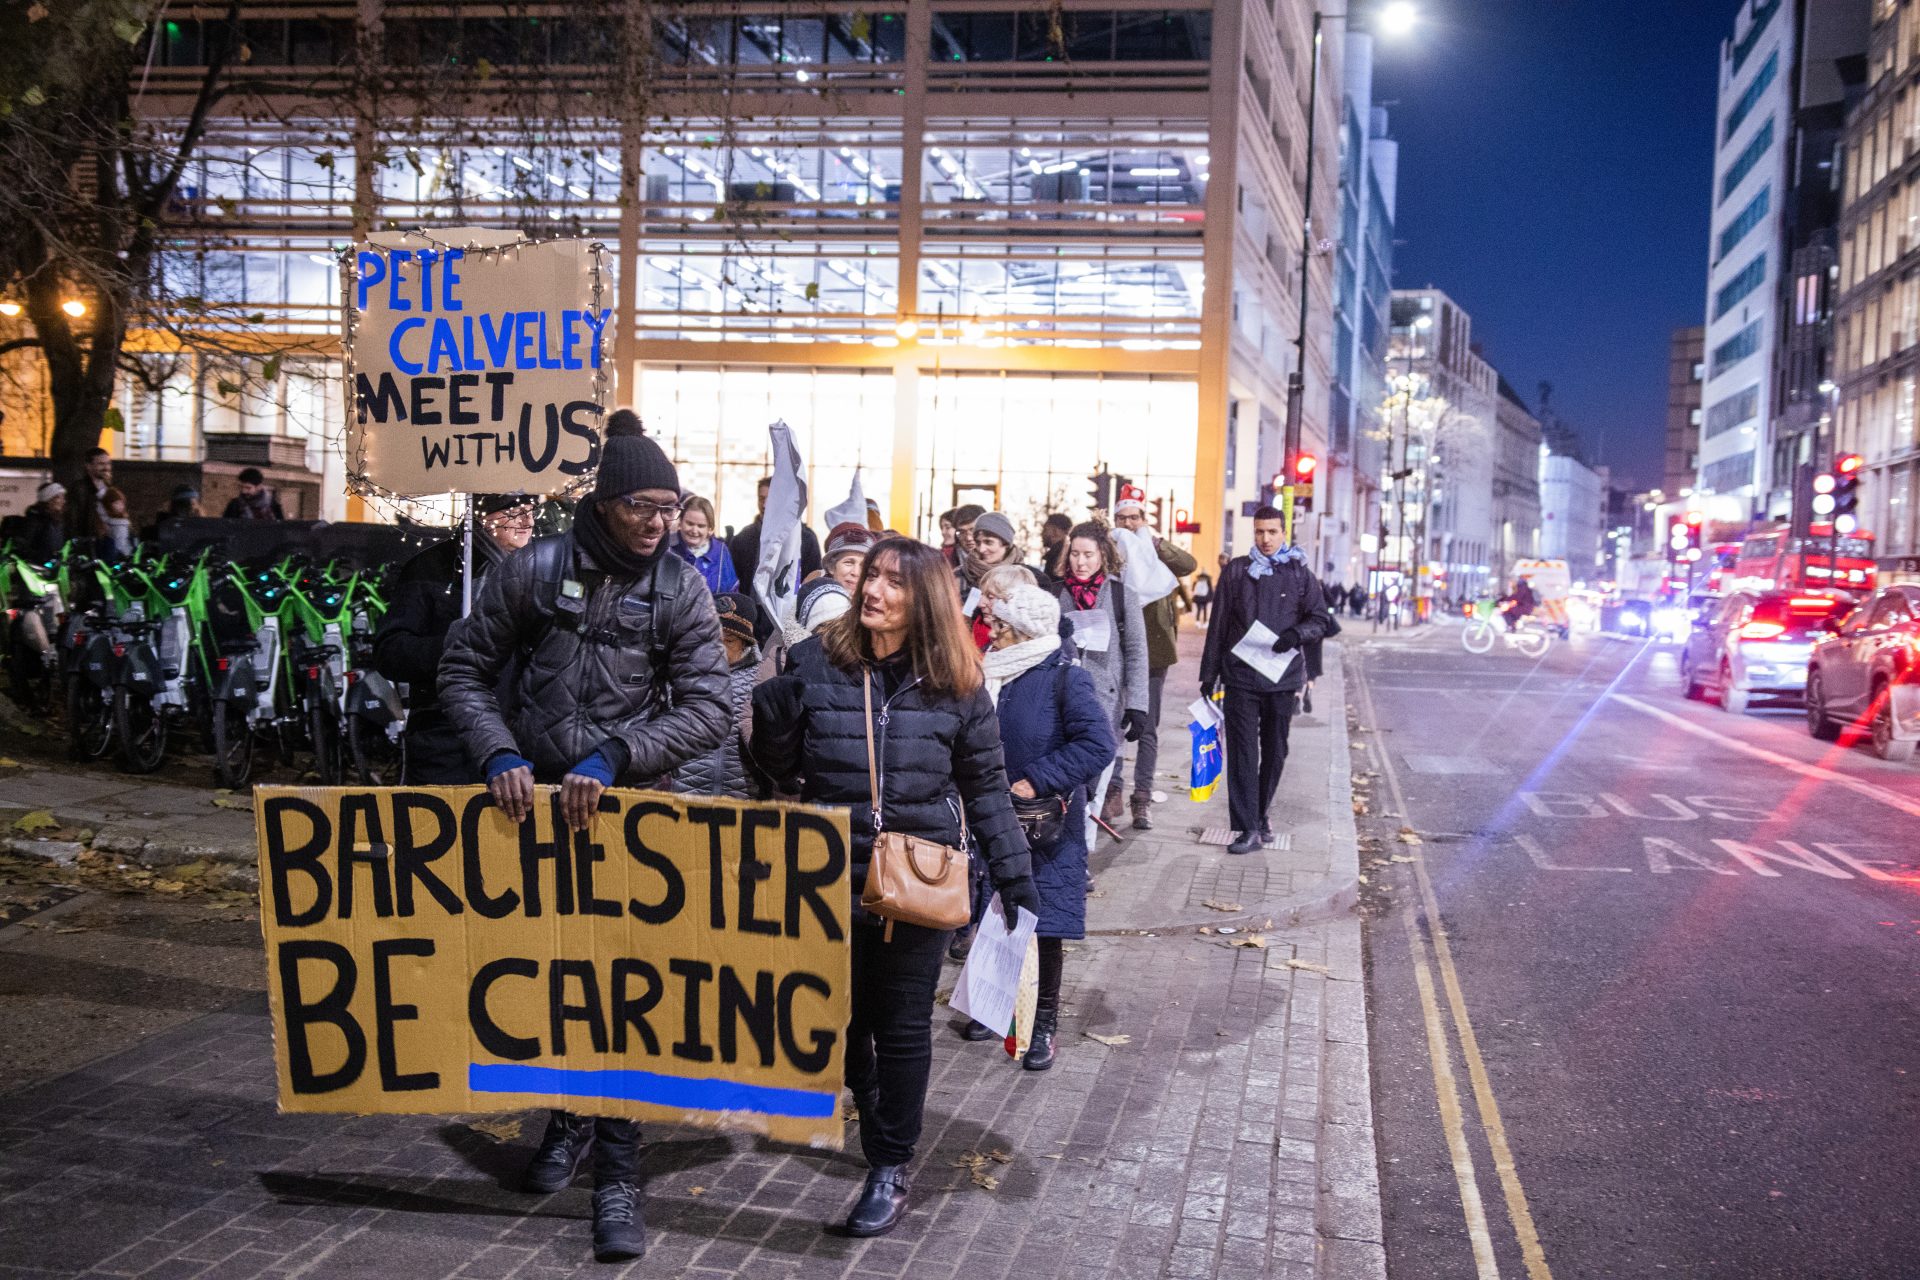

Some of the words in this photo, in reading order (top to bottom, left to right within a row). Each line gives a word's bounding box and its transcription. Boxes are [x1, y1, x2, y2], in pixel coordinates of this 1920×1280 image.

[357, 249, 464, 312] PETE
[389, 308, 611, 375] CALVELEY
[356, 371, 514, 425] MEET
[422, 431, 515, 471] WITH
[518, 400, 604, 475] US
[1520, 791, 1790, 822] BUS
[264, 792, 849, 941] BARCHESTER
[1513, 836, 1920, 882] LANE
[278, 938, 440, 1093] BE
[468, 958, 836, 1073] CARING
